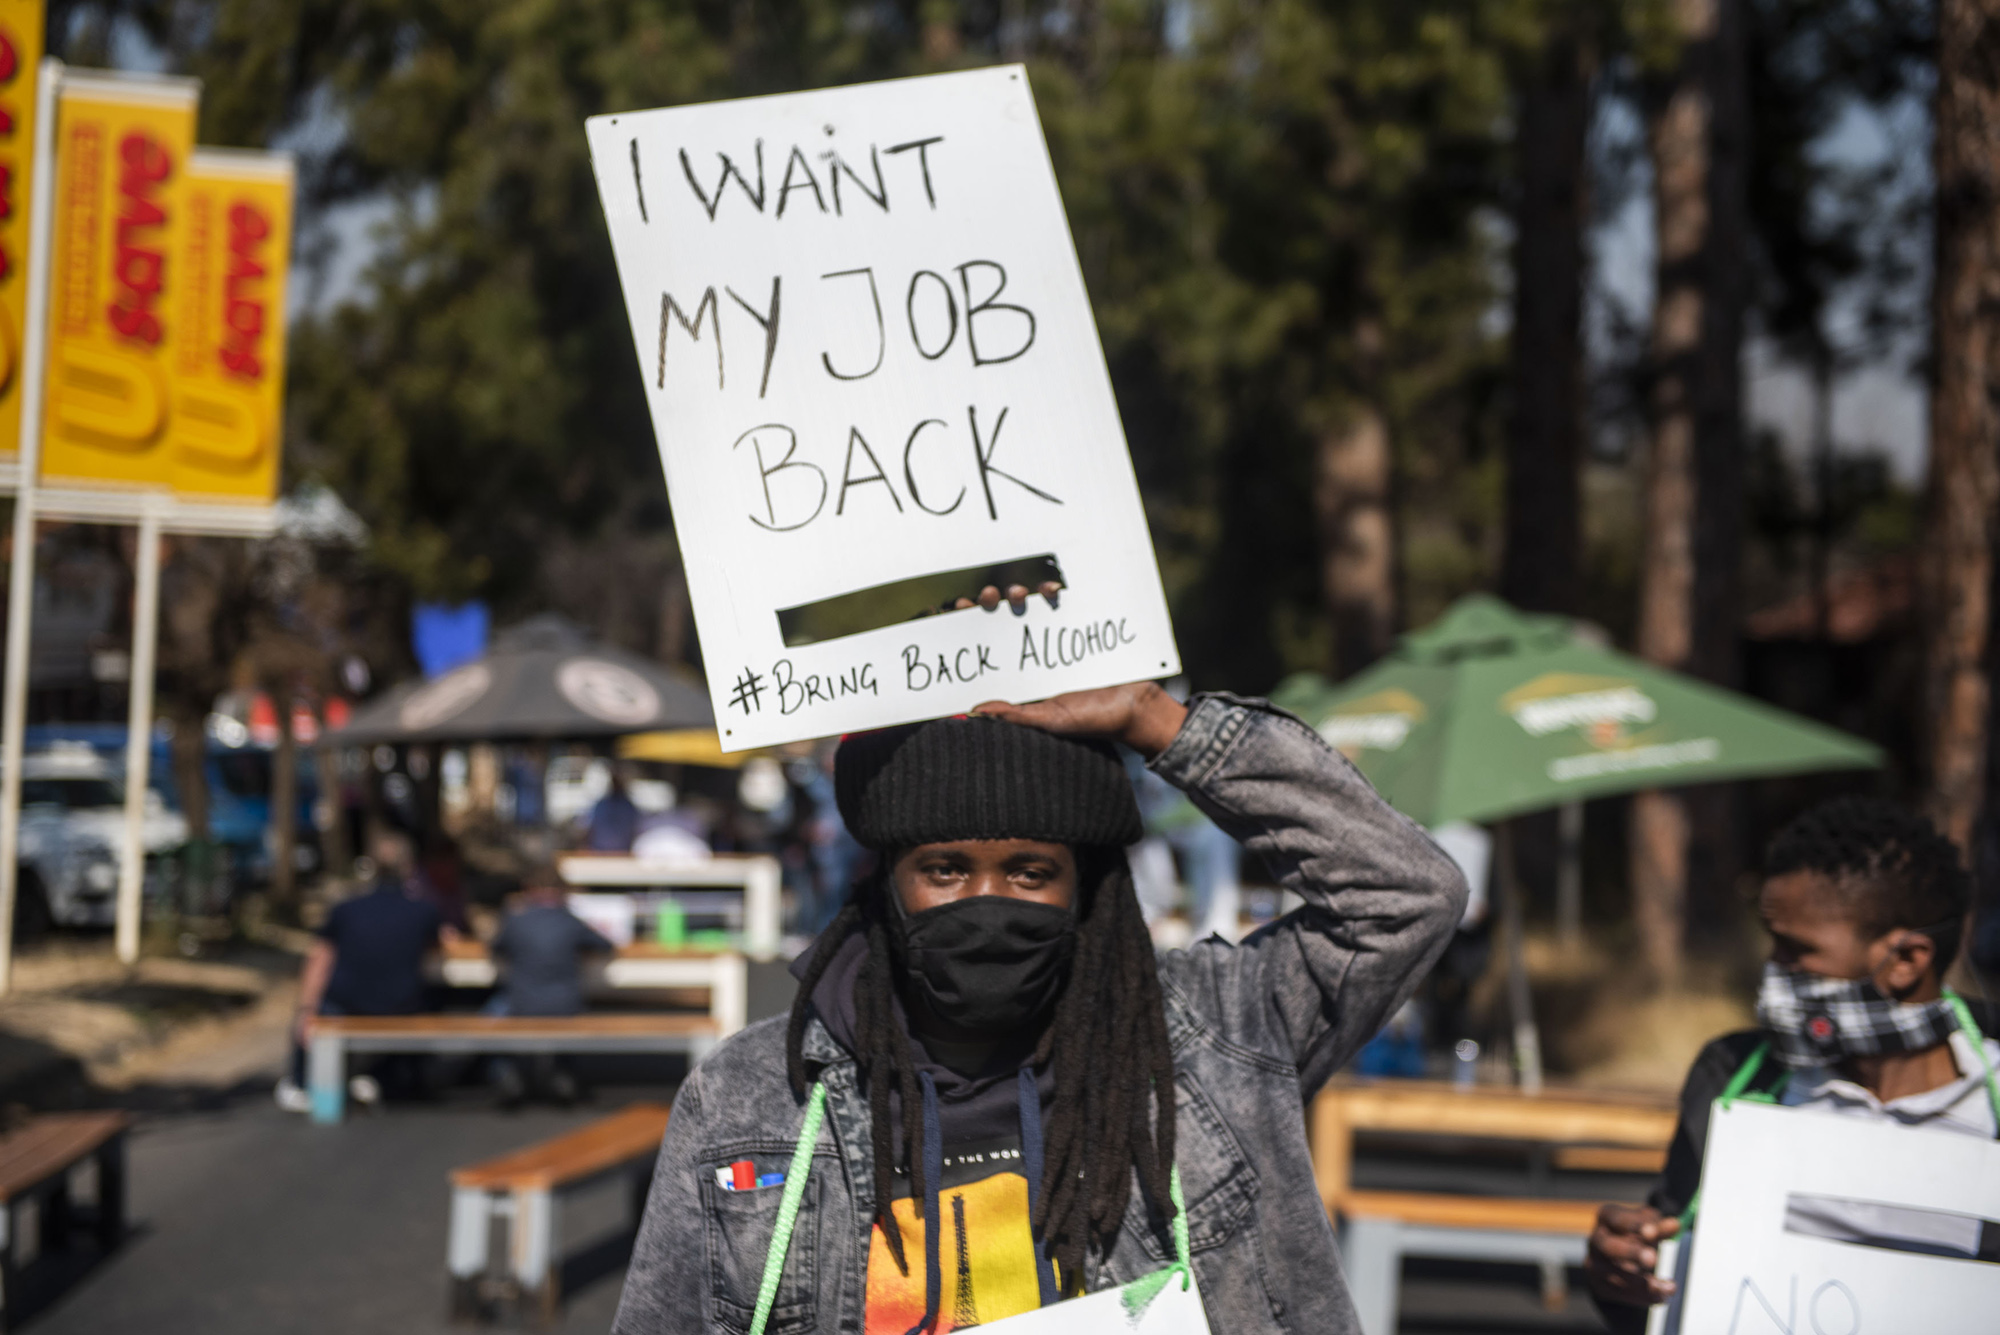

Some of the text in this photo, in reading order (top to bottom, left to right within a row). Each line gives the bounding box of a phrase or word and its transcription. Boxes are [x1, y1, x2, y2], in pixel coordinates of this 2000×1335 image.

[629, 135, 946, 224] I WANT
[656, 260, 1037, 399] MY JOB
[732, 404, 1065, 532] BACK
[1728, 1271, 1862, 1335] NO
